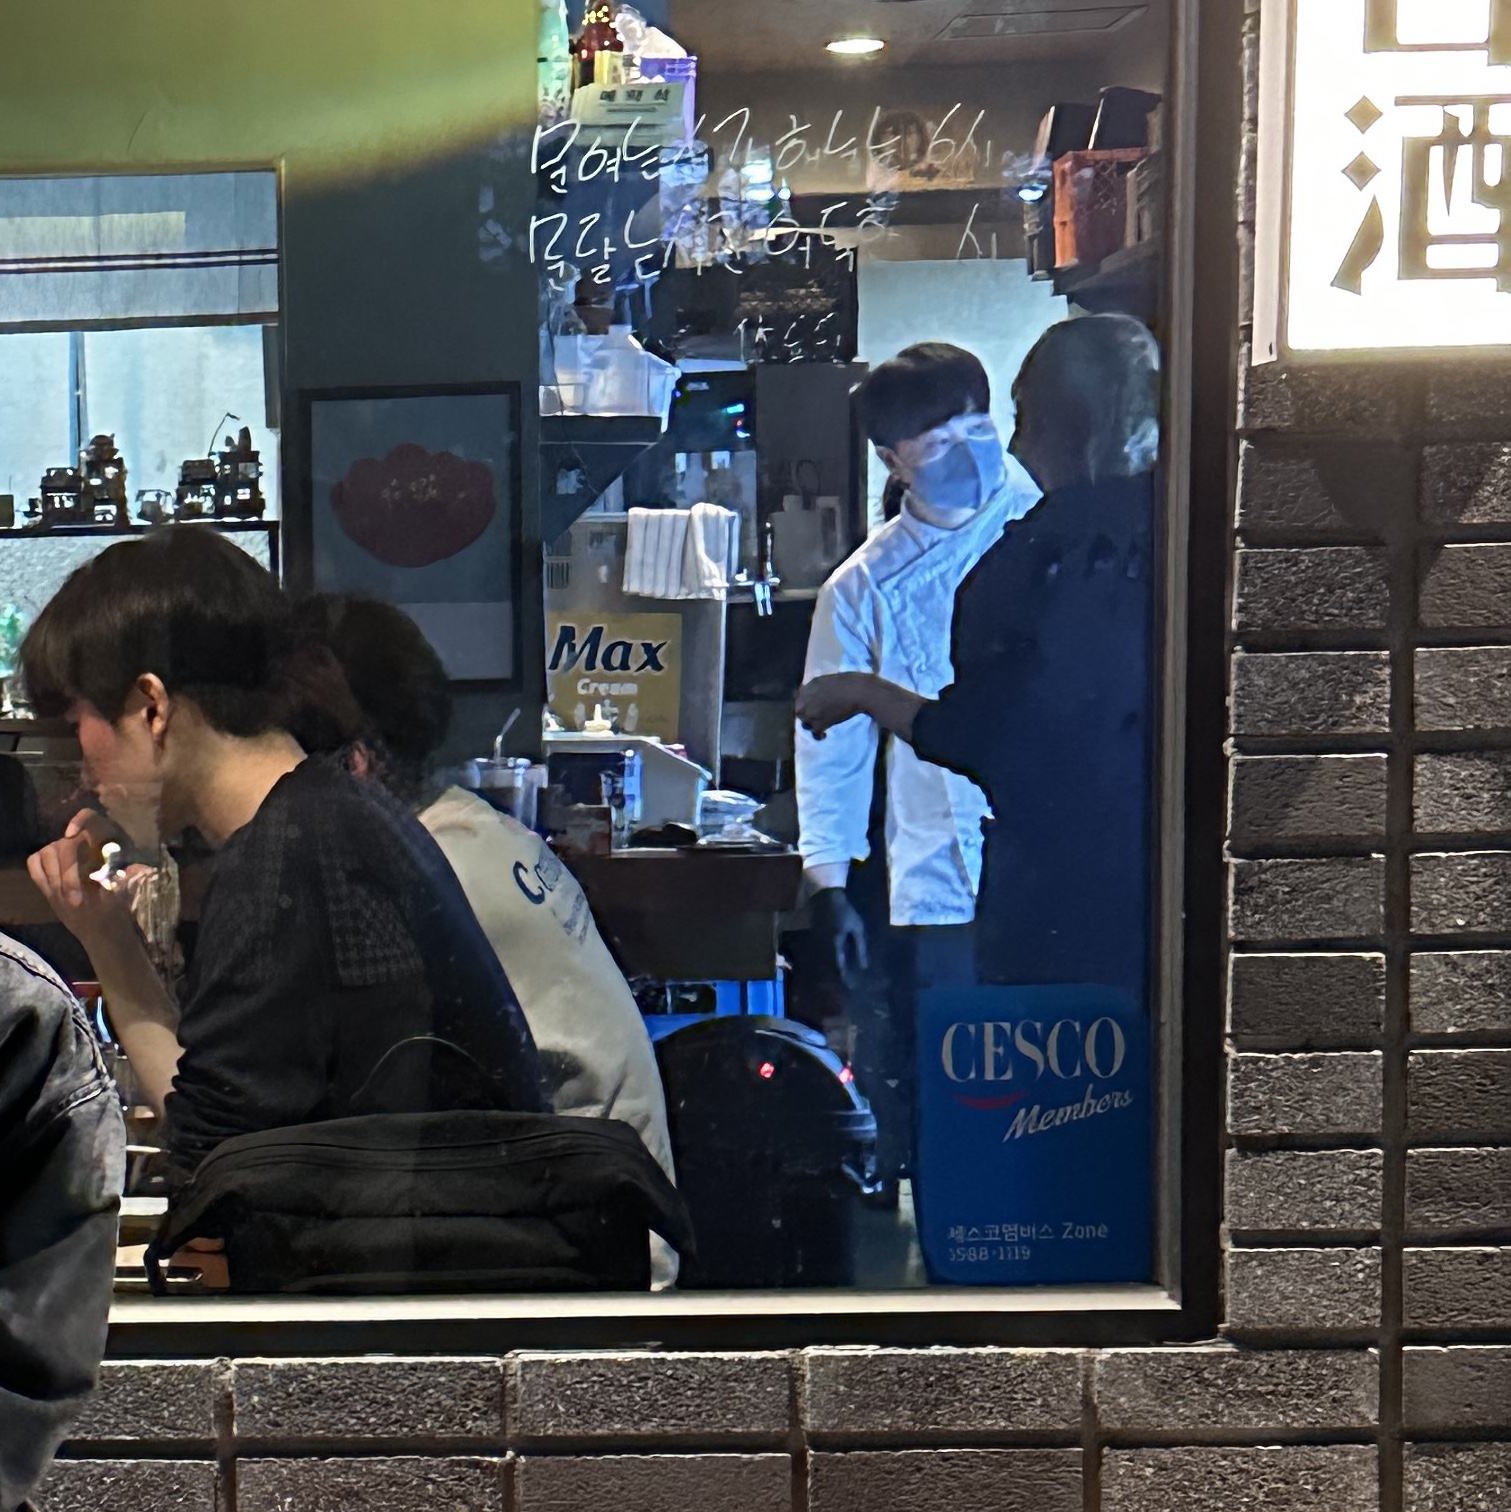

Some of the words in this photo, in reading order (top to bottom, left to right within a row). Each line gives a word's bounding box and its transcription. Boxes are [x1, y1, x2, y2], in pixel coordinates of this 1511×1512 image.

[547, 624, 668, 673] Max
[941, 1016, 1126, 1083] CESCO
[1001, 1082, 1135, 1144] Members
[1062, 1221, 1110, 1240] Zone
